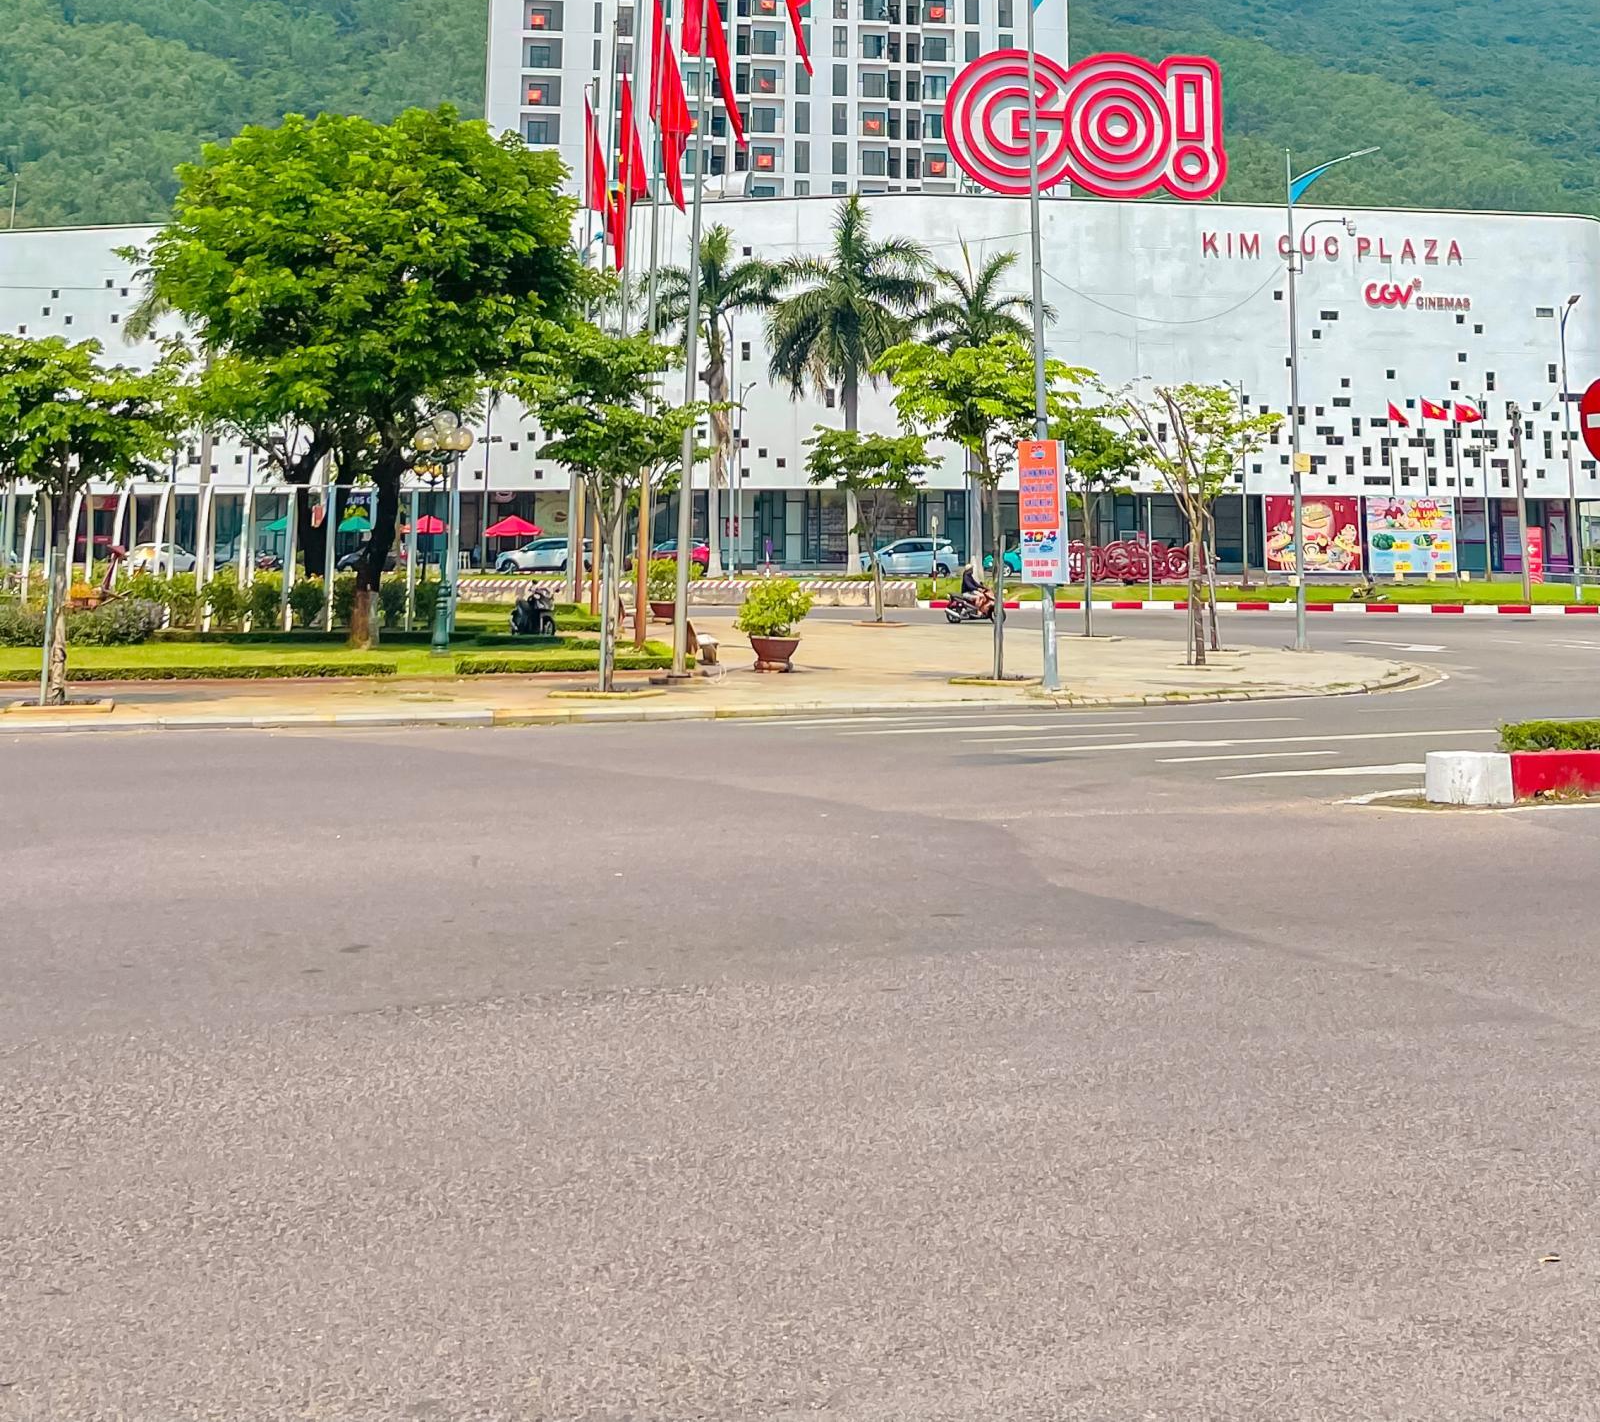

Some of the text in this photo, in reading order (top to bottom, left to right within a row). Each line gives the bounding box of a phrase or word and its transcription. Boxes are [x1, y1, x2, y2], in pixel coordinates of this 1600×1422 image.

[943, 49, 1228, 200] GO!
[1202, 231, 1260, 260] KIM
[1356, 236, 1463, 266] PLAZA
[1364, 281, 1414, 309] CGV
[1416, 295, 1471, 312] CINEMAS
